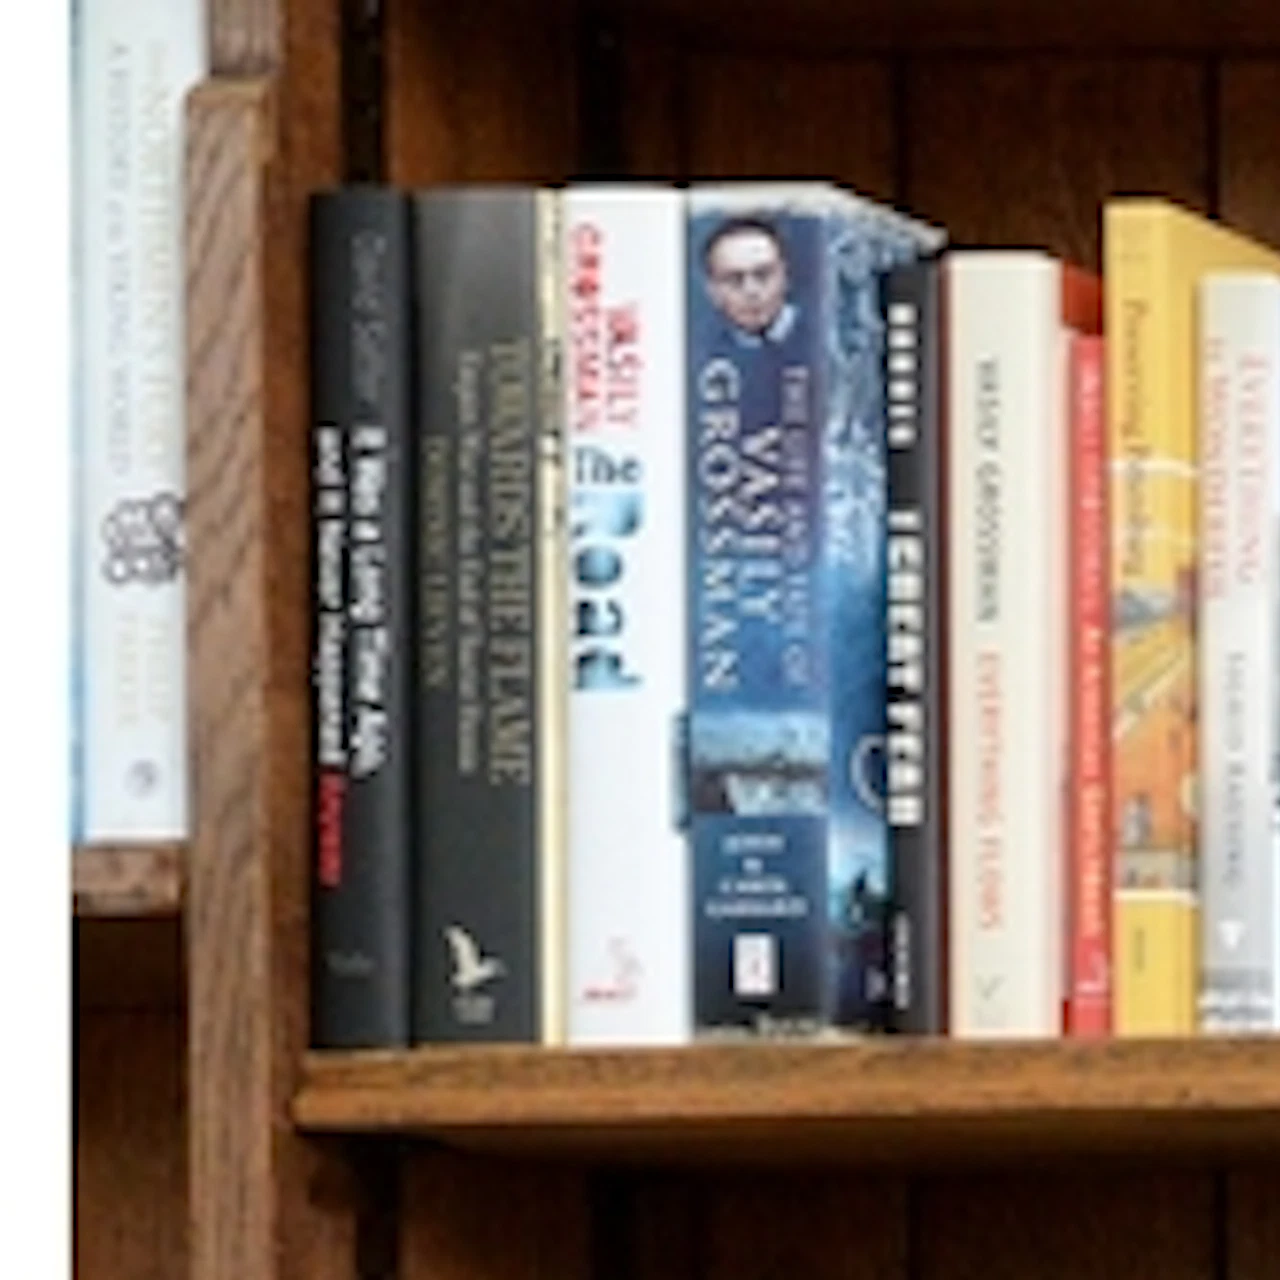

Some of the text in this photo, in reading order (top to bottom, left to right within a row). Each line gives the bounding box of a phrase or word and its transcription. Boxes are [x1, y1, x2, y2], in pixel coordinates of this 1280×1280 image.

[573, 224, 604, 432] GROSSMAN
[606, 304, 642, 429] VASILY
[488, 337, 531, 786] TOWARDS THE FLAME
[576, 447, 640, 485] The
[698, 359, 737, 692] GROSSMAN
[741, 426, 779, 624] VASILY
[975, 460, 1003, 623] GROSSMAN
[573, 493, 643, 691] Road
[975, 653, 1005, 931] EVERYTHING FLOWS
